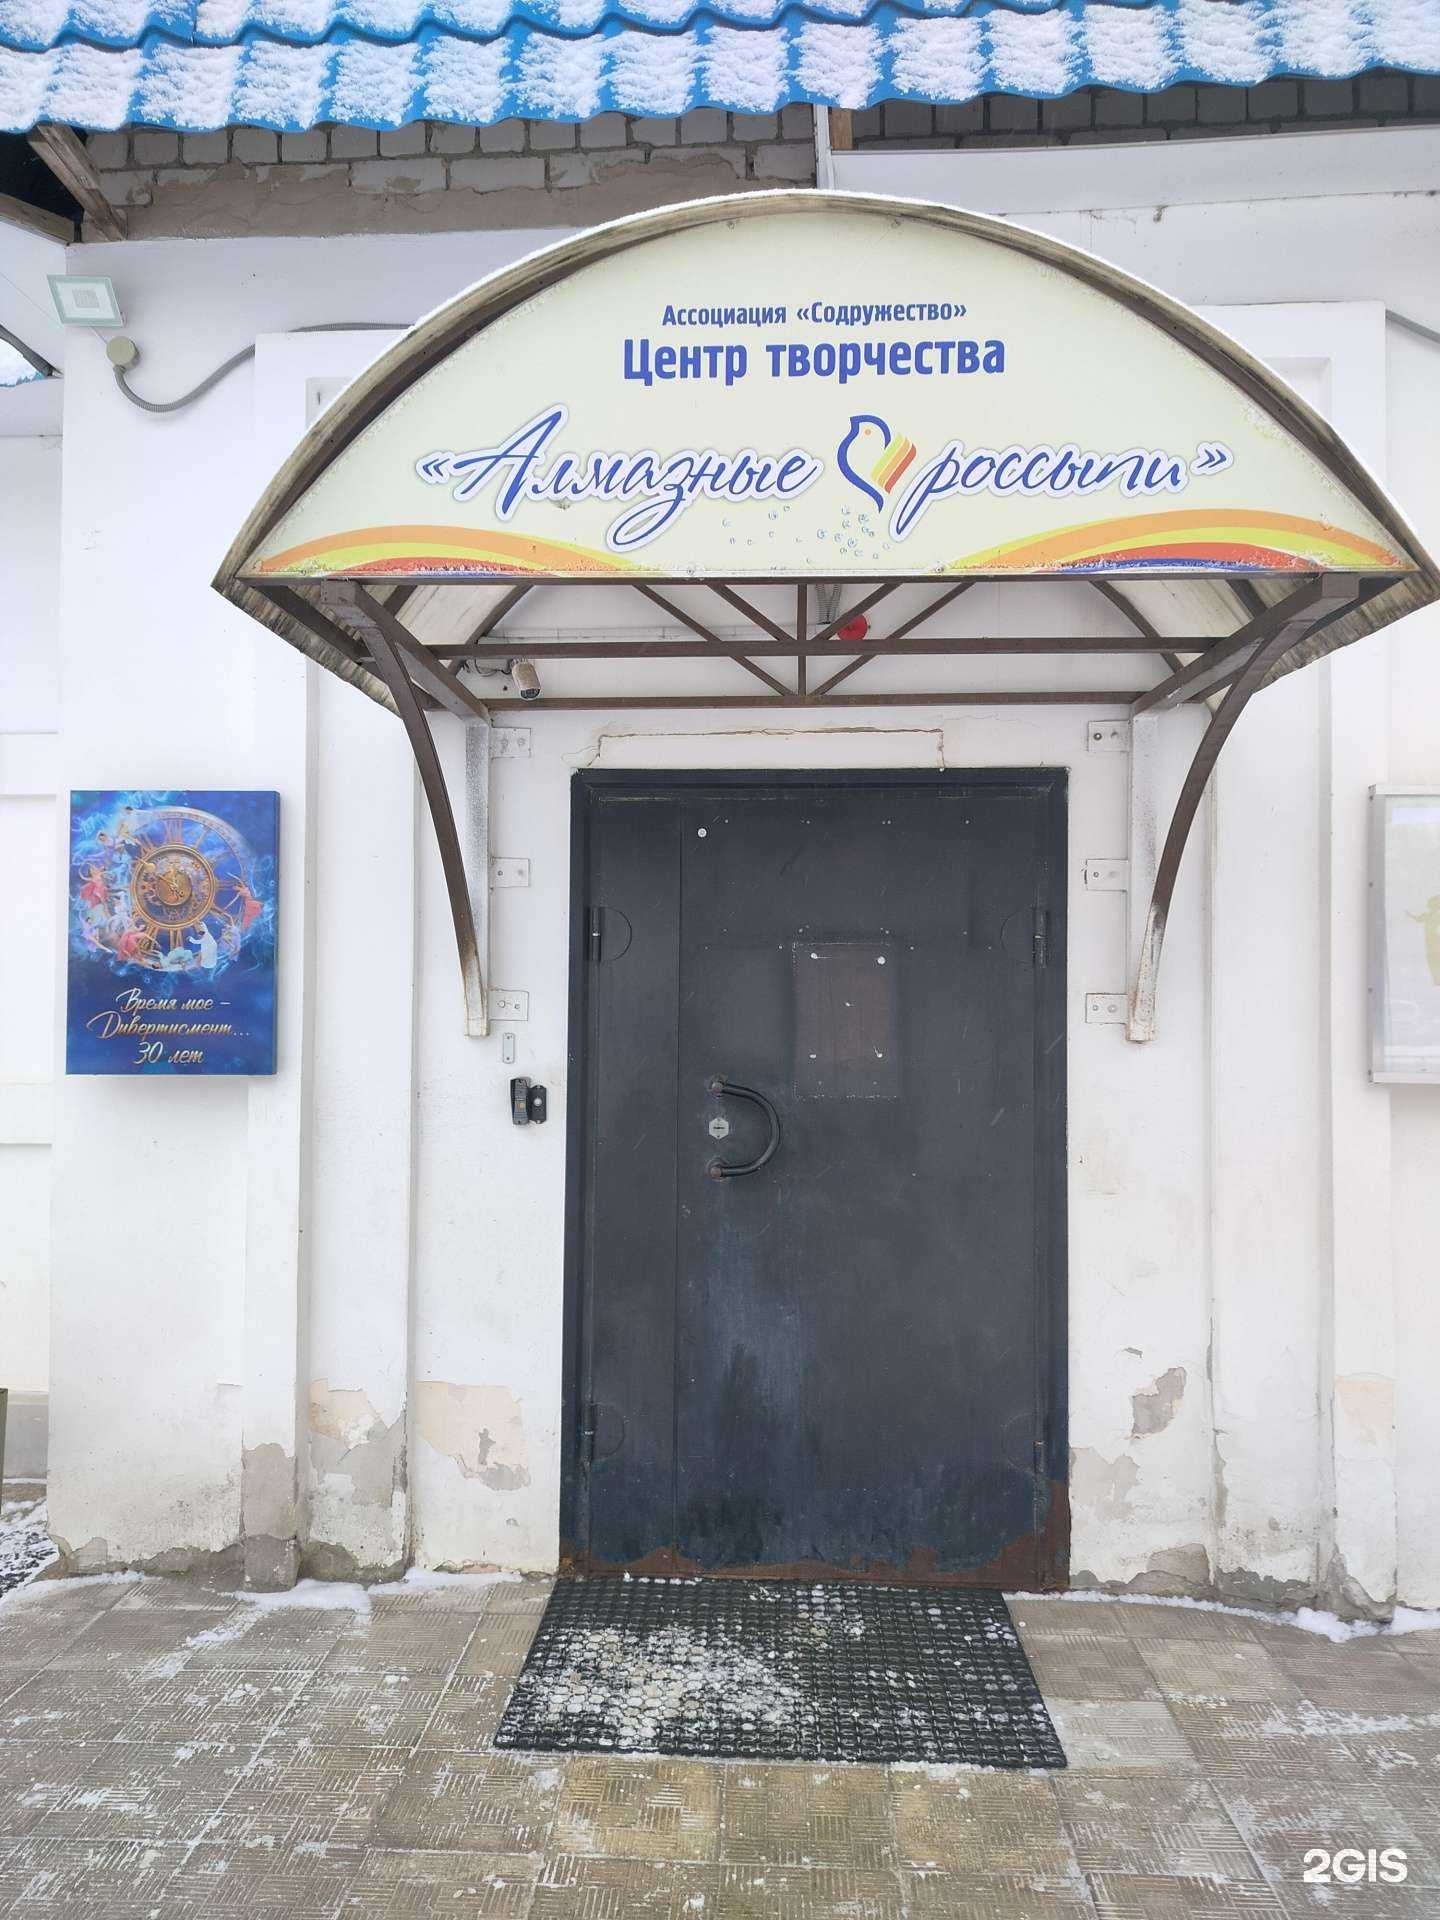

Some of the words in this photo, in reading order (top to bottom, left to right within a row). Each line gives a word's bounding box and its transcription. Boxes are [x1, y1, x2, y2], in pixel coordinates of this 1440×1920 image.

[662, 304, 787, 328] Ассоциация
[796, 301, 967, 327] «Содружество»
[623, 338, 748, 386] Центр
[766, 339, 1005, 384] творчества
[422, 410, 818, 546] «Алмазные
[896, 447, 1227, 535] россыпи»
[116, 987, 177, 1015] Время
[181, 998, 214, 1011] мое
[133, 1041, 164, 1064] 30
[167, 1048, 205, 1063] лет
